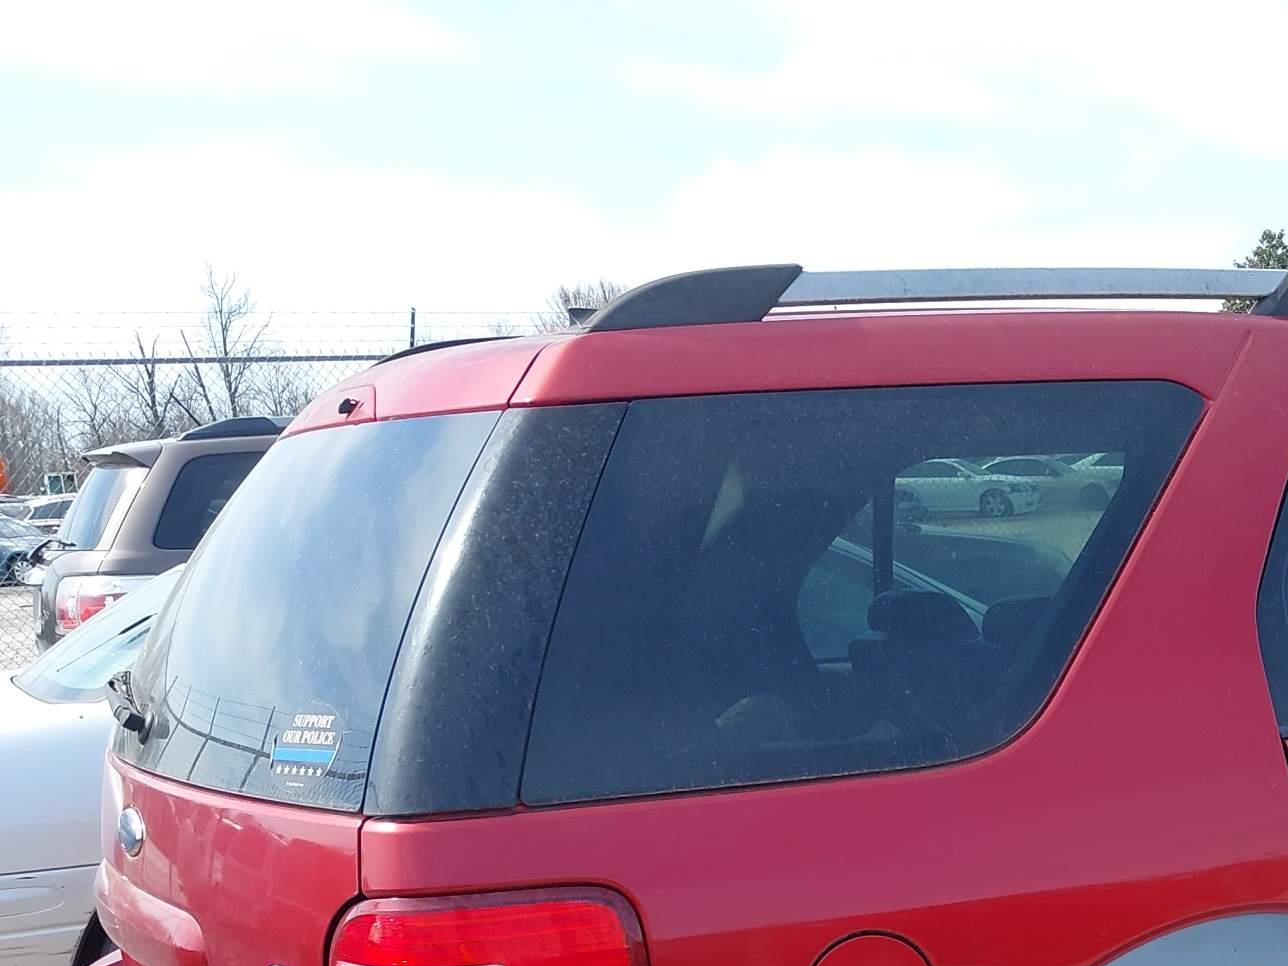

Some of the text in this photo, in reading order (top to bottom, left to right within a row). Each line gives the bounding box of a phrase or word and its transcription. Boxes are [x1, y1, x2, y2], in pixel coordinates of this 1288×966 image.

[293, 714, 336, 729] SUPPORT
[282, 730, 336, 745] OUR POLICE
